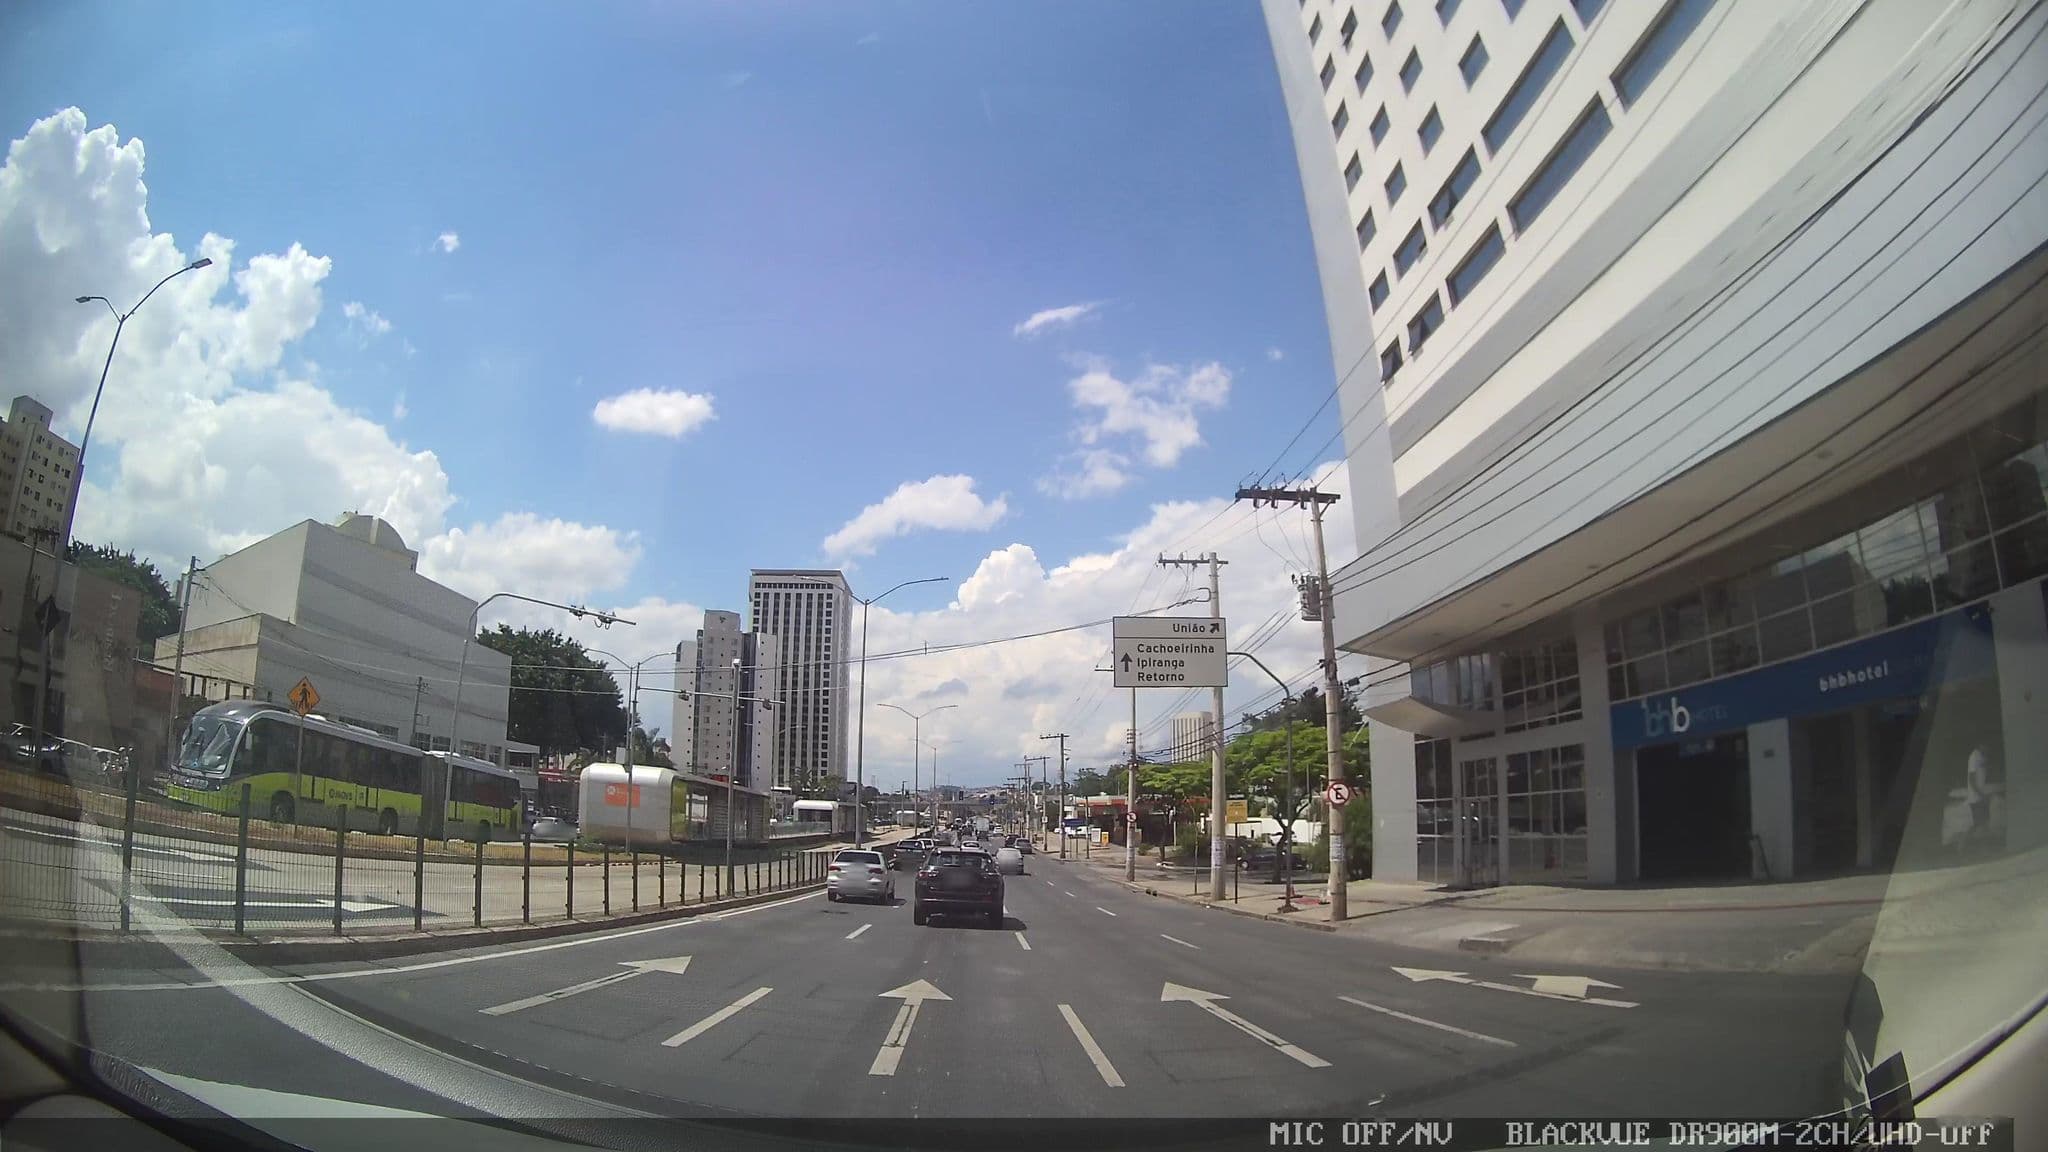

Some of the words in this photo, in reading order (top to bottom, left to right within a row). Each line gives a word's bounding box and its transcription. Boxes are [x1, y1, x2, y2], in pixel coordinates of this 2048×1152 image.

[1172, 622, 1206, 633] União
[1137, 643, 1215, 654] Cachoeirinha
[1137, 657, 1185, 669] Ipiranga
[1138, 672, 1185, 682] Retorno
